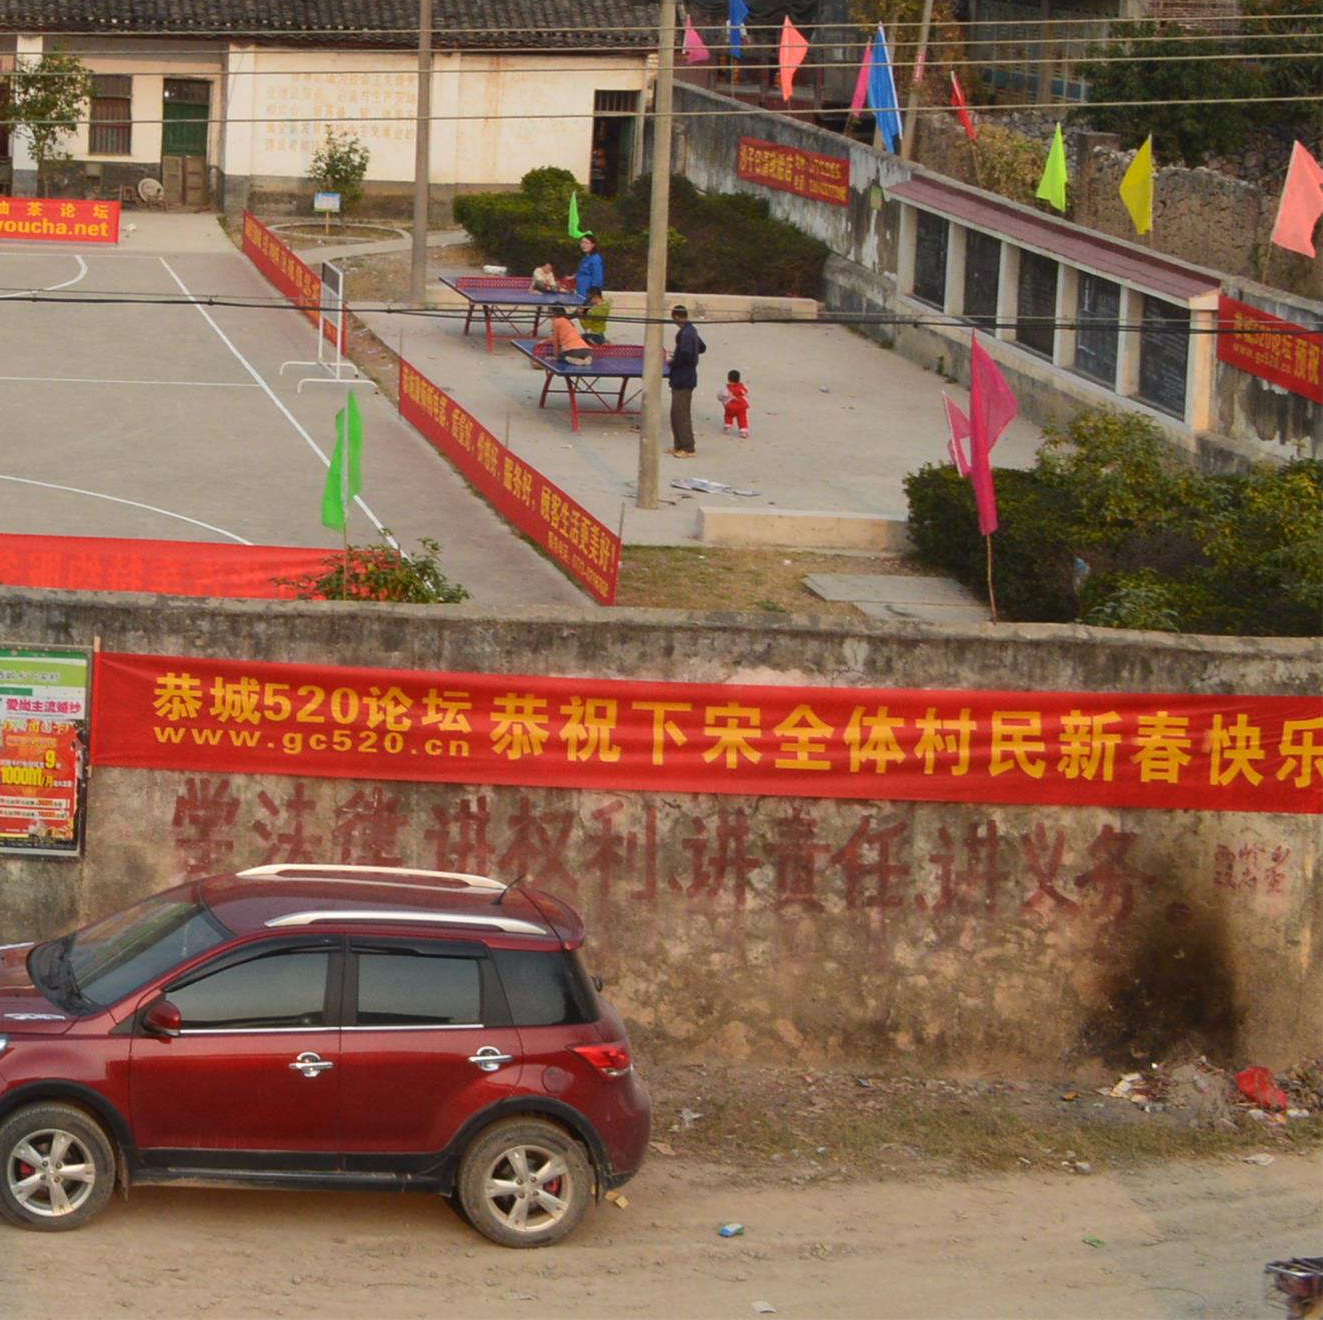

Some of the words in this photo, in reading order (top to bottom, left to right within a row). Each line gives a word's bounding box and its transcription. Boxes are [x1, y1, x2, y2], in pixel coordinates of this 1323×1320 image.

[152, 672, 473, 734] 恭城520论坛
[489, 691, 1323, 789] 恭祝下宋全体村民新春快乐
[153, 726, 471, 758] www.gc520.cn
